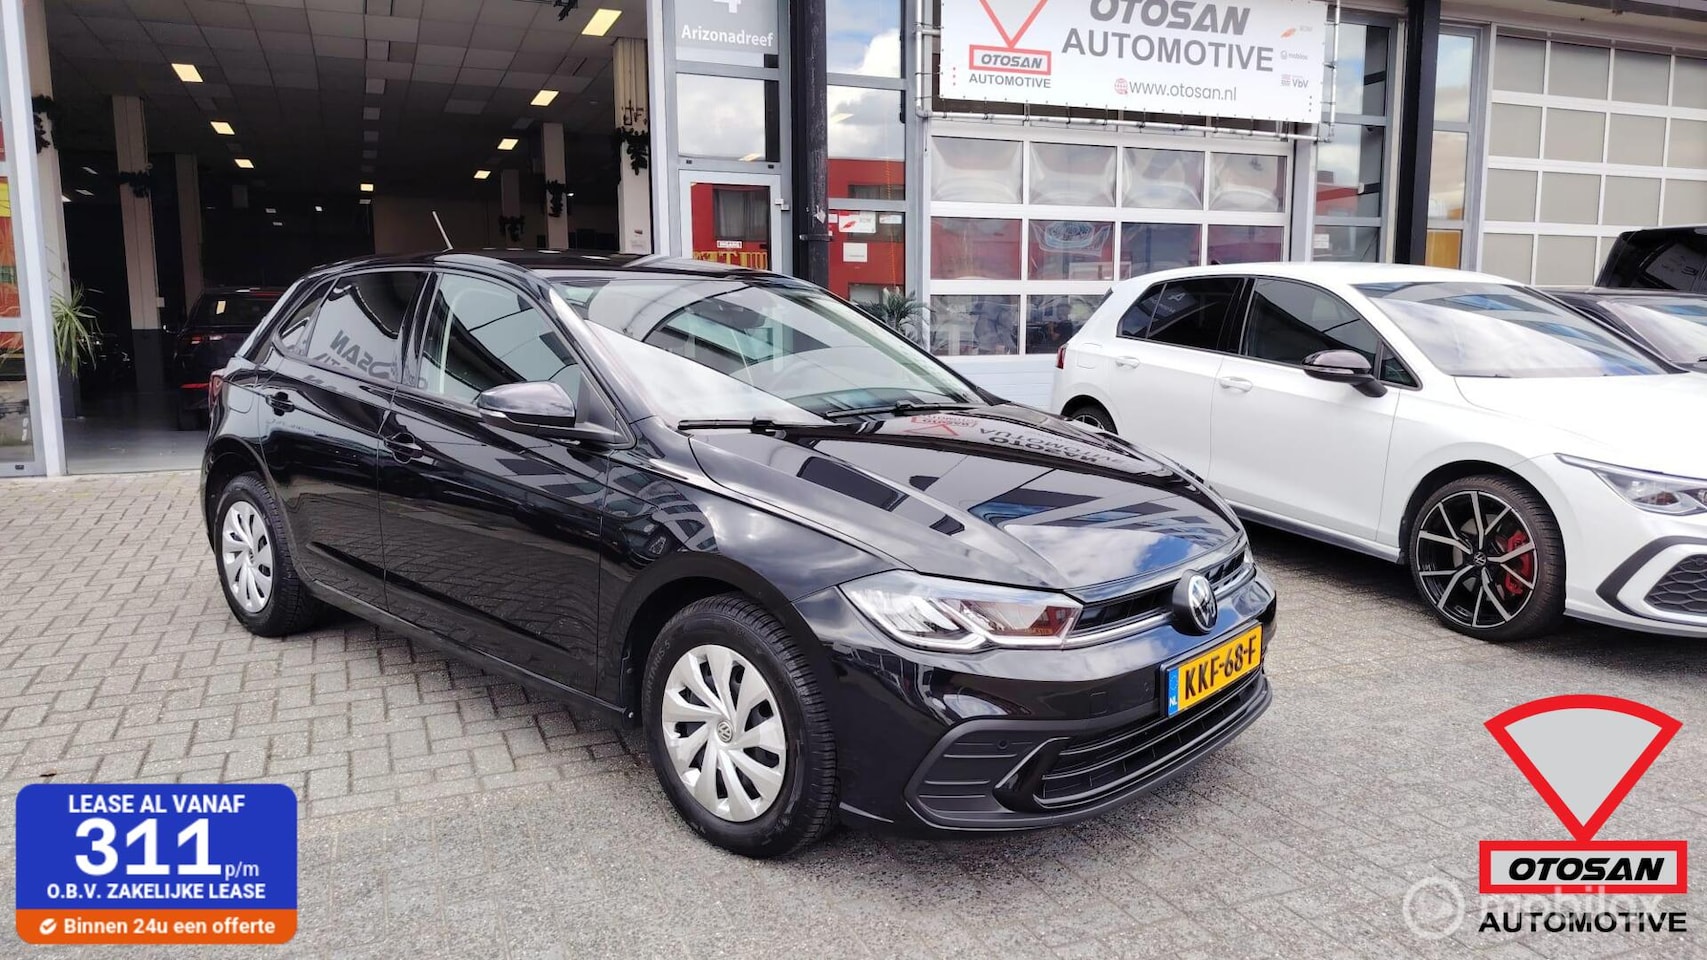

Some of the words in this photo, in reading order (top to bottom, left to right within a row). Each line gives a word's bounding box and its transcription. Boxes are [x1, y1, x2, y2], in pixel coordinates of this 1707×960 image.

[1089, 0, 1251, 36] OTOSAN
[681, 24, 774, 47] Arizonadreef
[1061, 28, 1274, 72] AUTOMOTIVE
[981, 53, 1043, 69] OTOSAN
[969, 73, 1052, 89] AUTOMOTIVE
[1129, 80, 1237, 101] www.otosan.nl
[1292, 79, 1309, 88] VbV
[1184, 635, 1257, 700] KKF-68-F
[1169, 696, 1178, 707] NL
